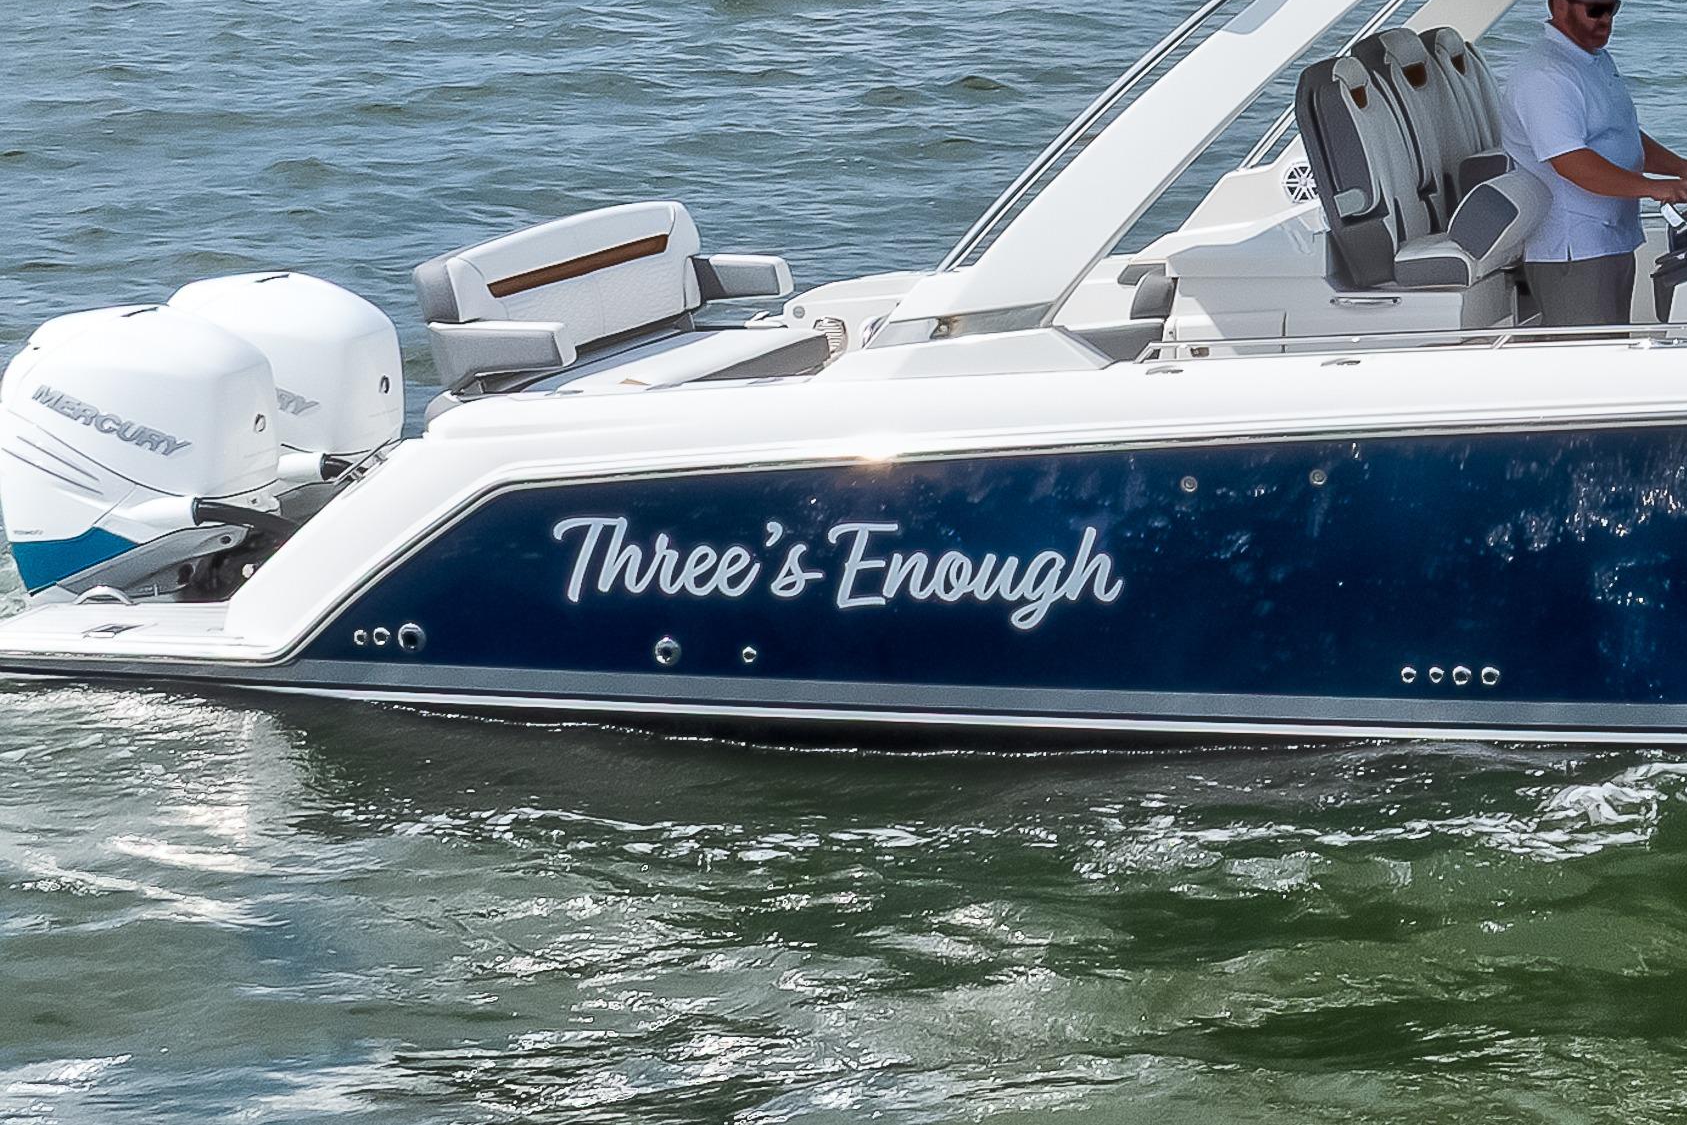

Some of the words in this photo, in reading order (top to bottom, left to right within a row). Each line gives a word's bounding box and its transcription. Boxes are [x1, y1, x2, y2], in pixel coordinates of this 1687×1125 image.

[31, 384, 192, 456] MERCURY
[552, 516, 823, 603] Three's
[827, 520, 1124, 630] Enough
